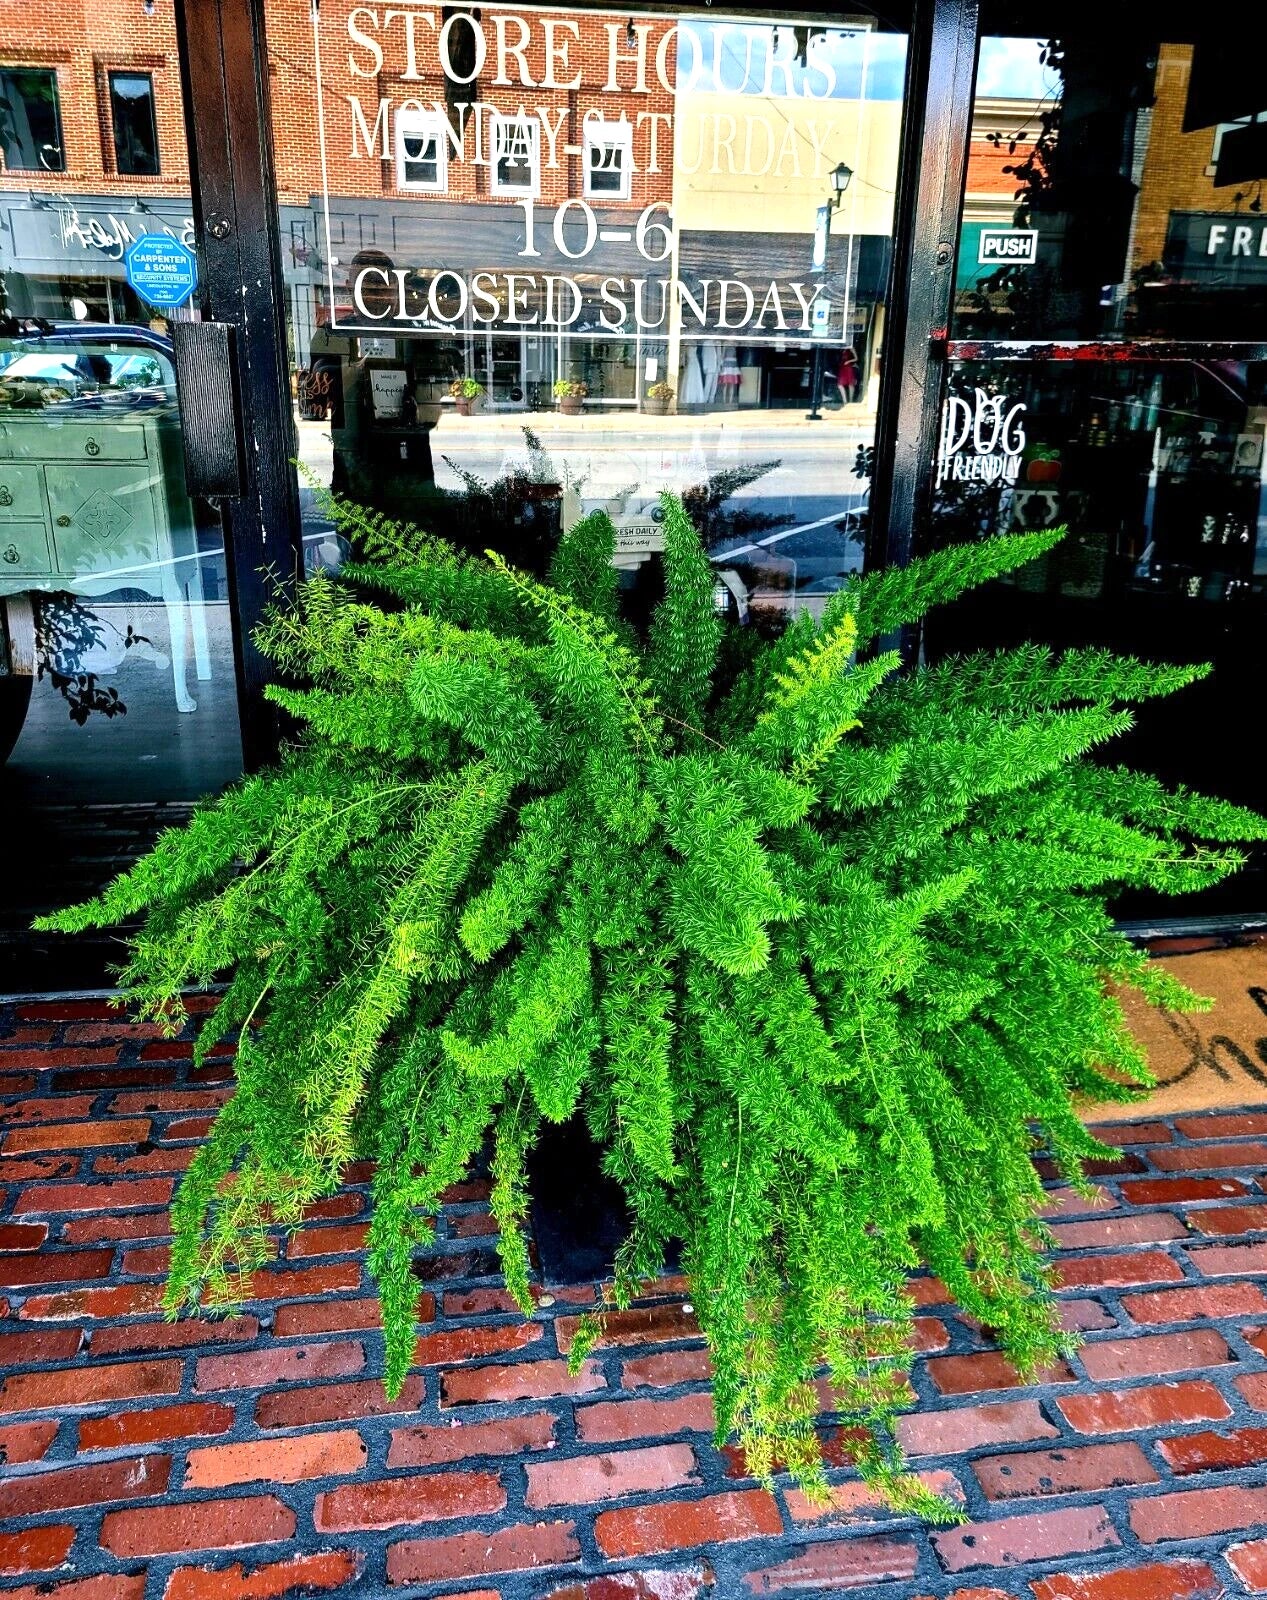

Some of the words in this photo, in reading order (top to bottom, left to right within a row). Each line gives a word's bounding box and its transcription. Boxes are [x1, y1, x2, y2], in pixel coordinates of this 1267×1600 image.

[348, 8, 582, 90] STORE
[601, 24, 837, 99] HOURS
[984, 238, 1031, 256] PUSH
[133, 254, 187, 264] CARPENTER
[144, 263, 151, 271] &
[153, 264, 178, 272] SONS
[353, 267, 583, 325] CLOSED
[600, 276, 827, 331] SUNDAY
[946, 388, 1028, 456] DOG
[943, 455, 1023, 481] FRIENDLY
[635, 527, 658, 535] DAILY
[620, 539, 635, 547] this
[636, 539, 650, 547] way
